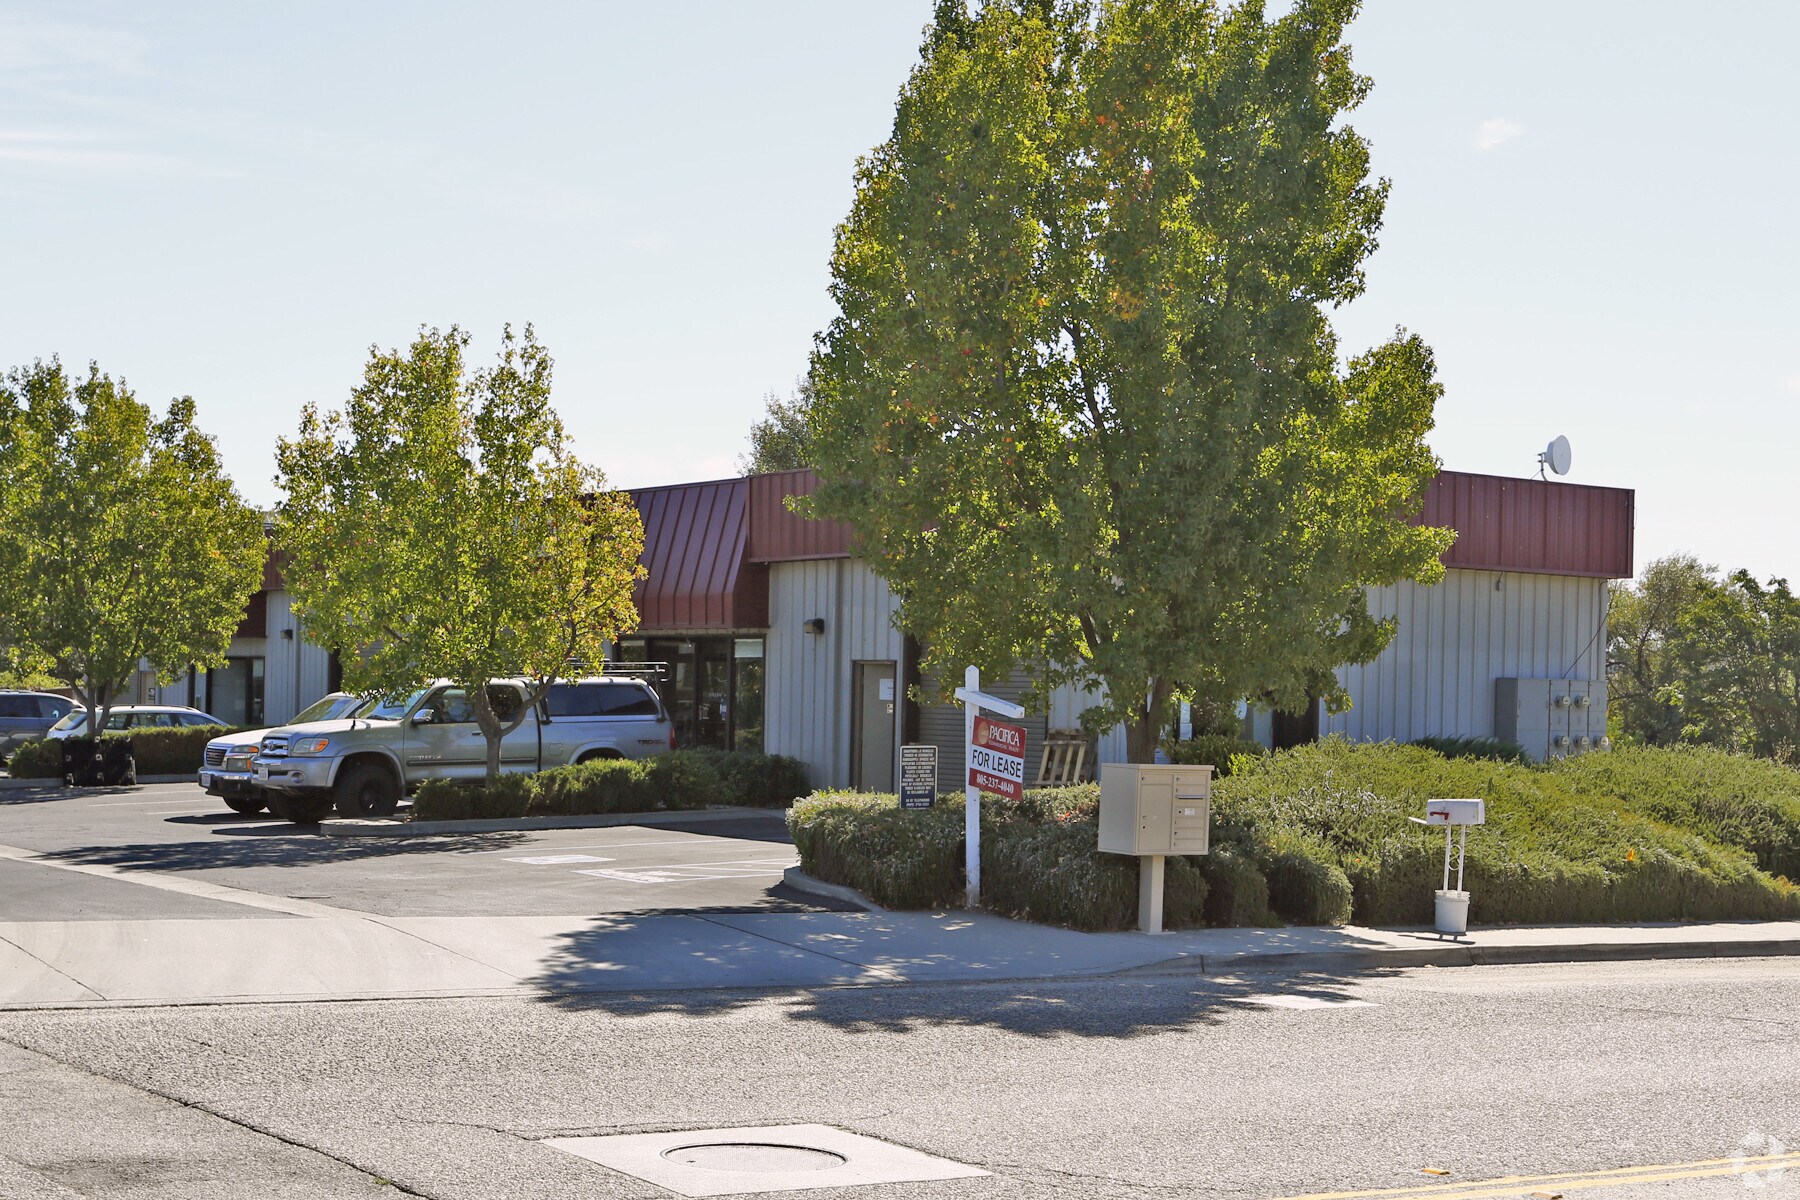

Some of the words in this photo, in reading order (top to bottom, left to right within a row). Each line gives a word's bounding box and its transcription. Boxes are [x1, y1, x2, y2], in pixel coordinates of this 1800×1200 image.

[989, 725, 1020, 747] PACIFICA
[972, 749, 990, 768] FOR
[991, 755, 1022, 778] LEASE
[976, 773, 1014, 794] 805-237-4040
